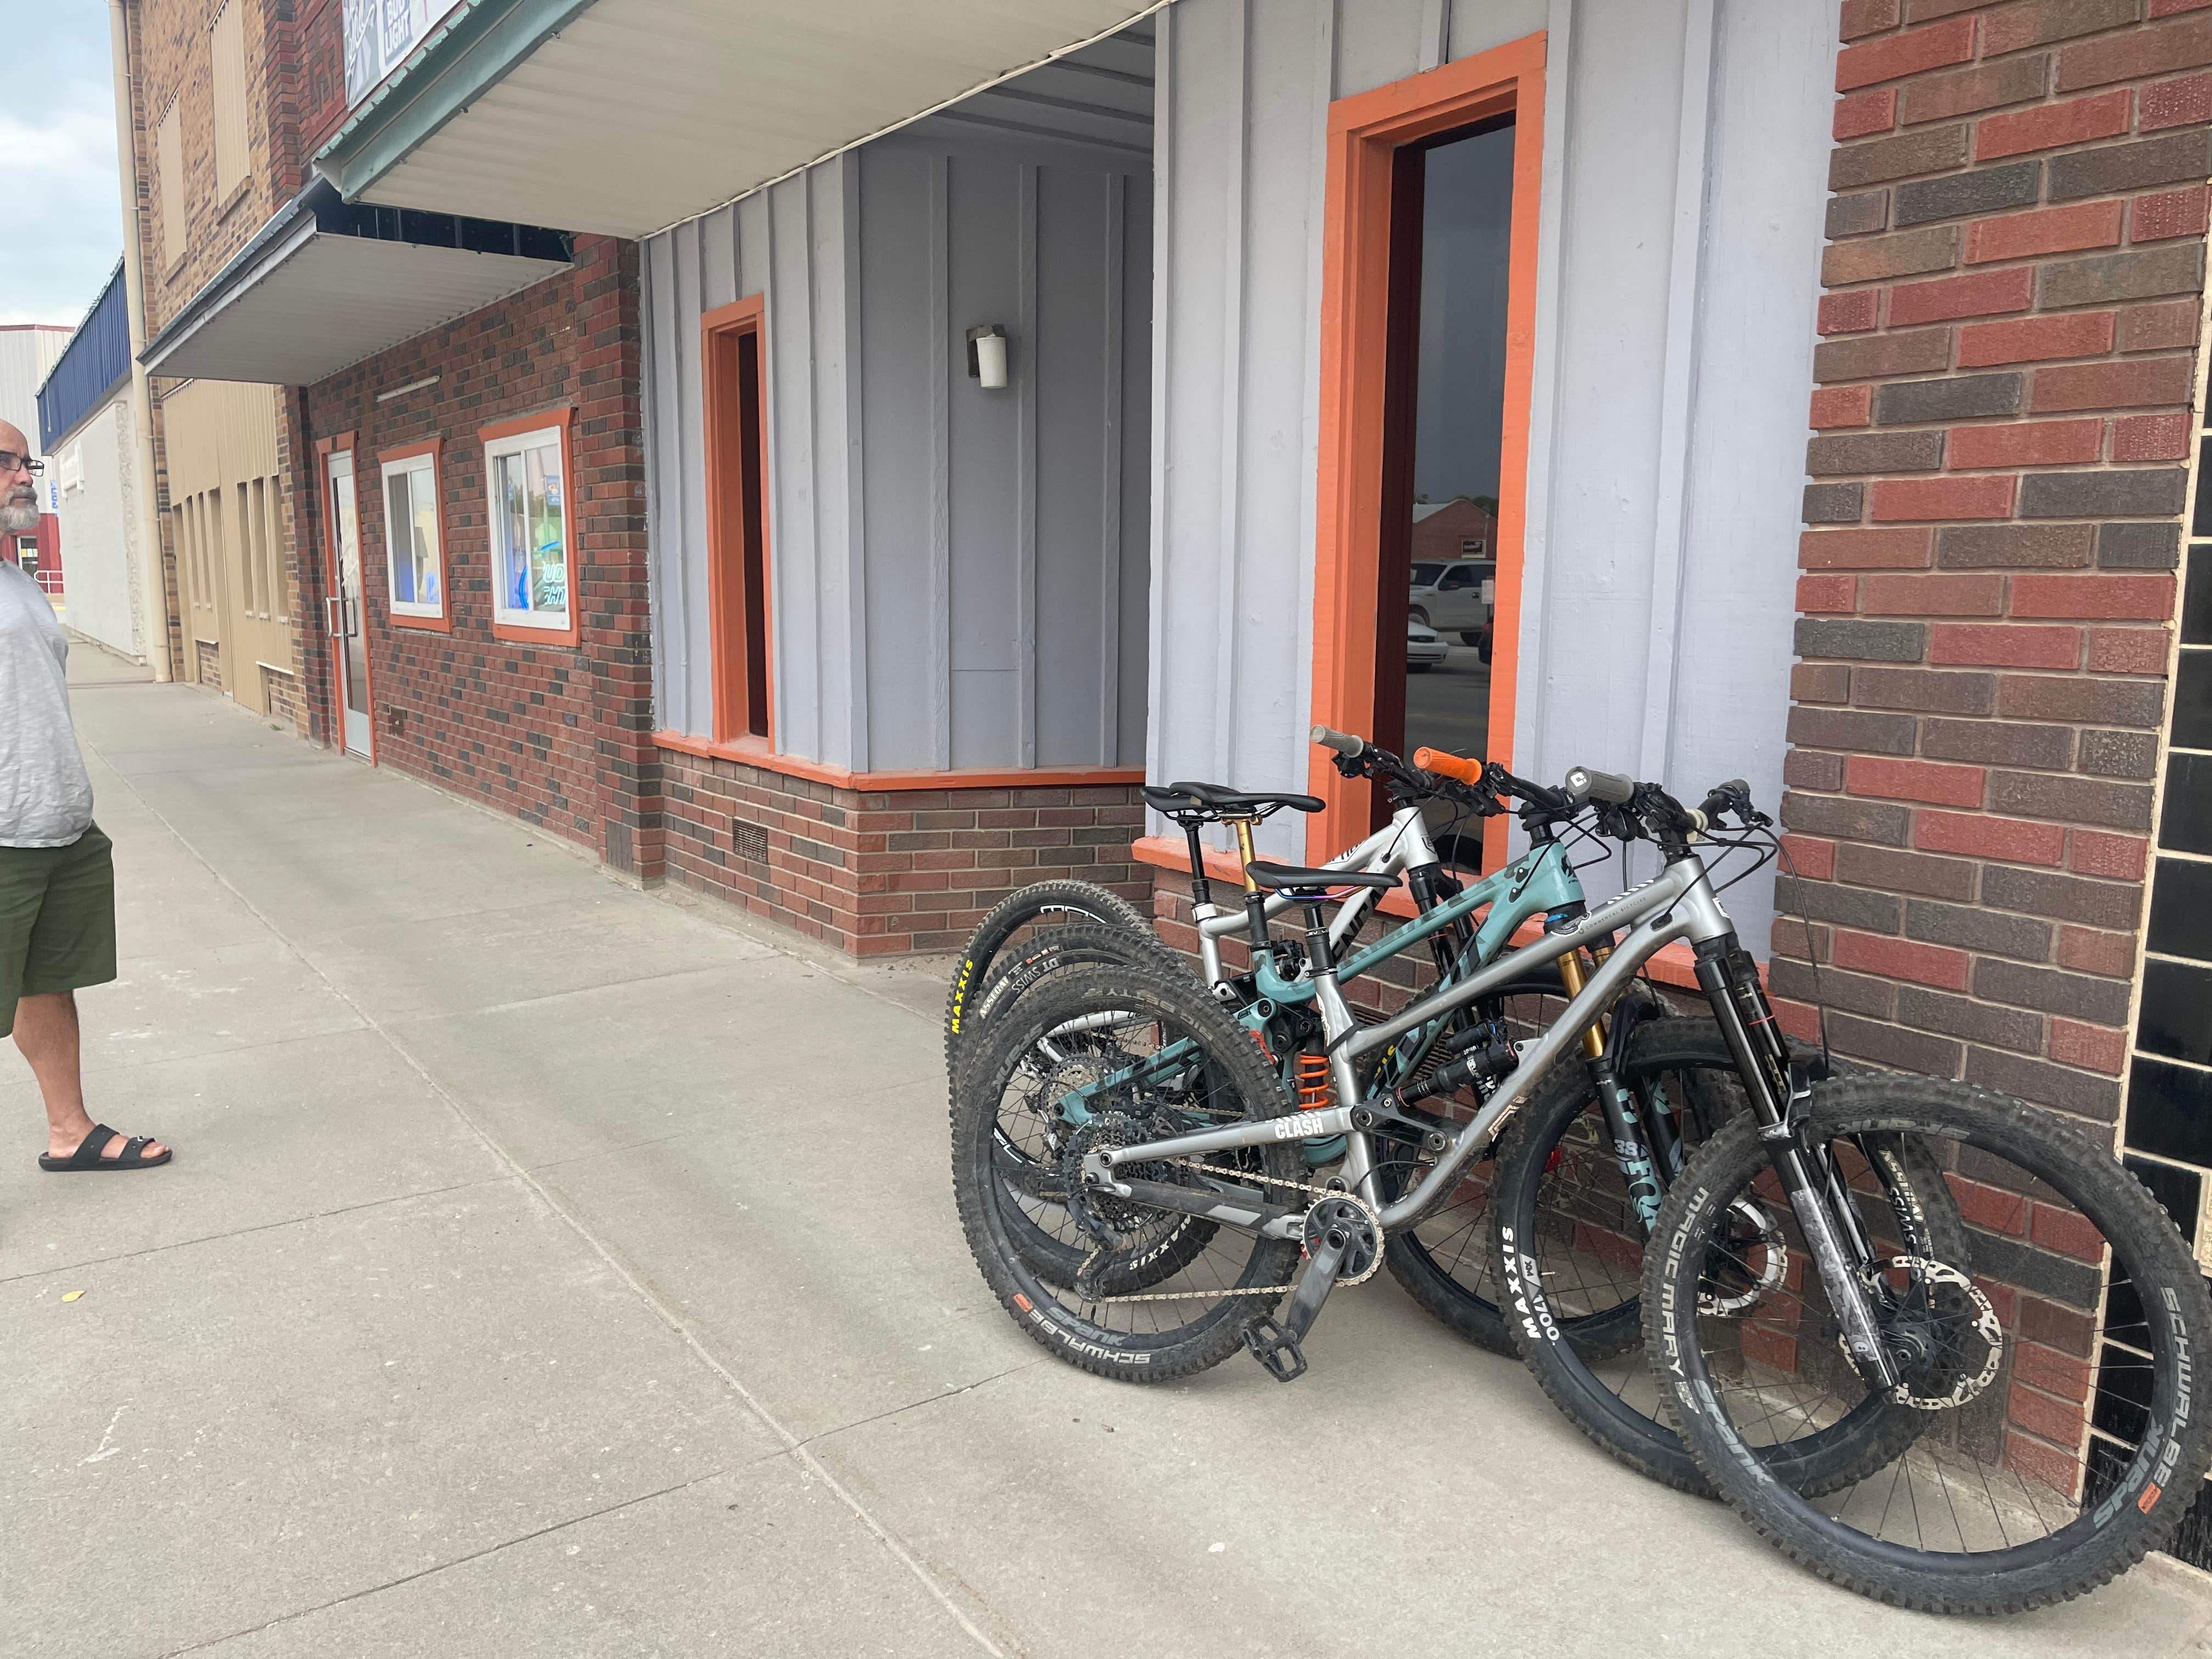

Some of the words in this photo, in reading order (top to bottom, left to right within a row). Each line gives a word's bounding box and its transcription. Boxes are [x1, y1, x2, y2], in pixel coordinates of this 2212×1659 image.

[385, 9, 409, 58] LIGHT
[542, 561, 565, 583] UD
[1012, 966, 1041, 994] SWISS
[1042, 957, 1060, 973] DT
[952, 960, 974, 1034] MAXXIS
[1274, 1117, 1324, 1139] CLASH
[1614, 1139, 1638, 1156] 38
[1664, 1187, 1711, 1279] MAGIC
[1502, 1226, 1542, 1339] MAXXIS
[1028, 1308, 1152, 1364] SCHWALBE
[1532, 1294, 1560, 1341] 1700
[1662, 1283, 1685, 1377] MARY
[2153, 1286, 2192, 1488] SCHWALBE
